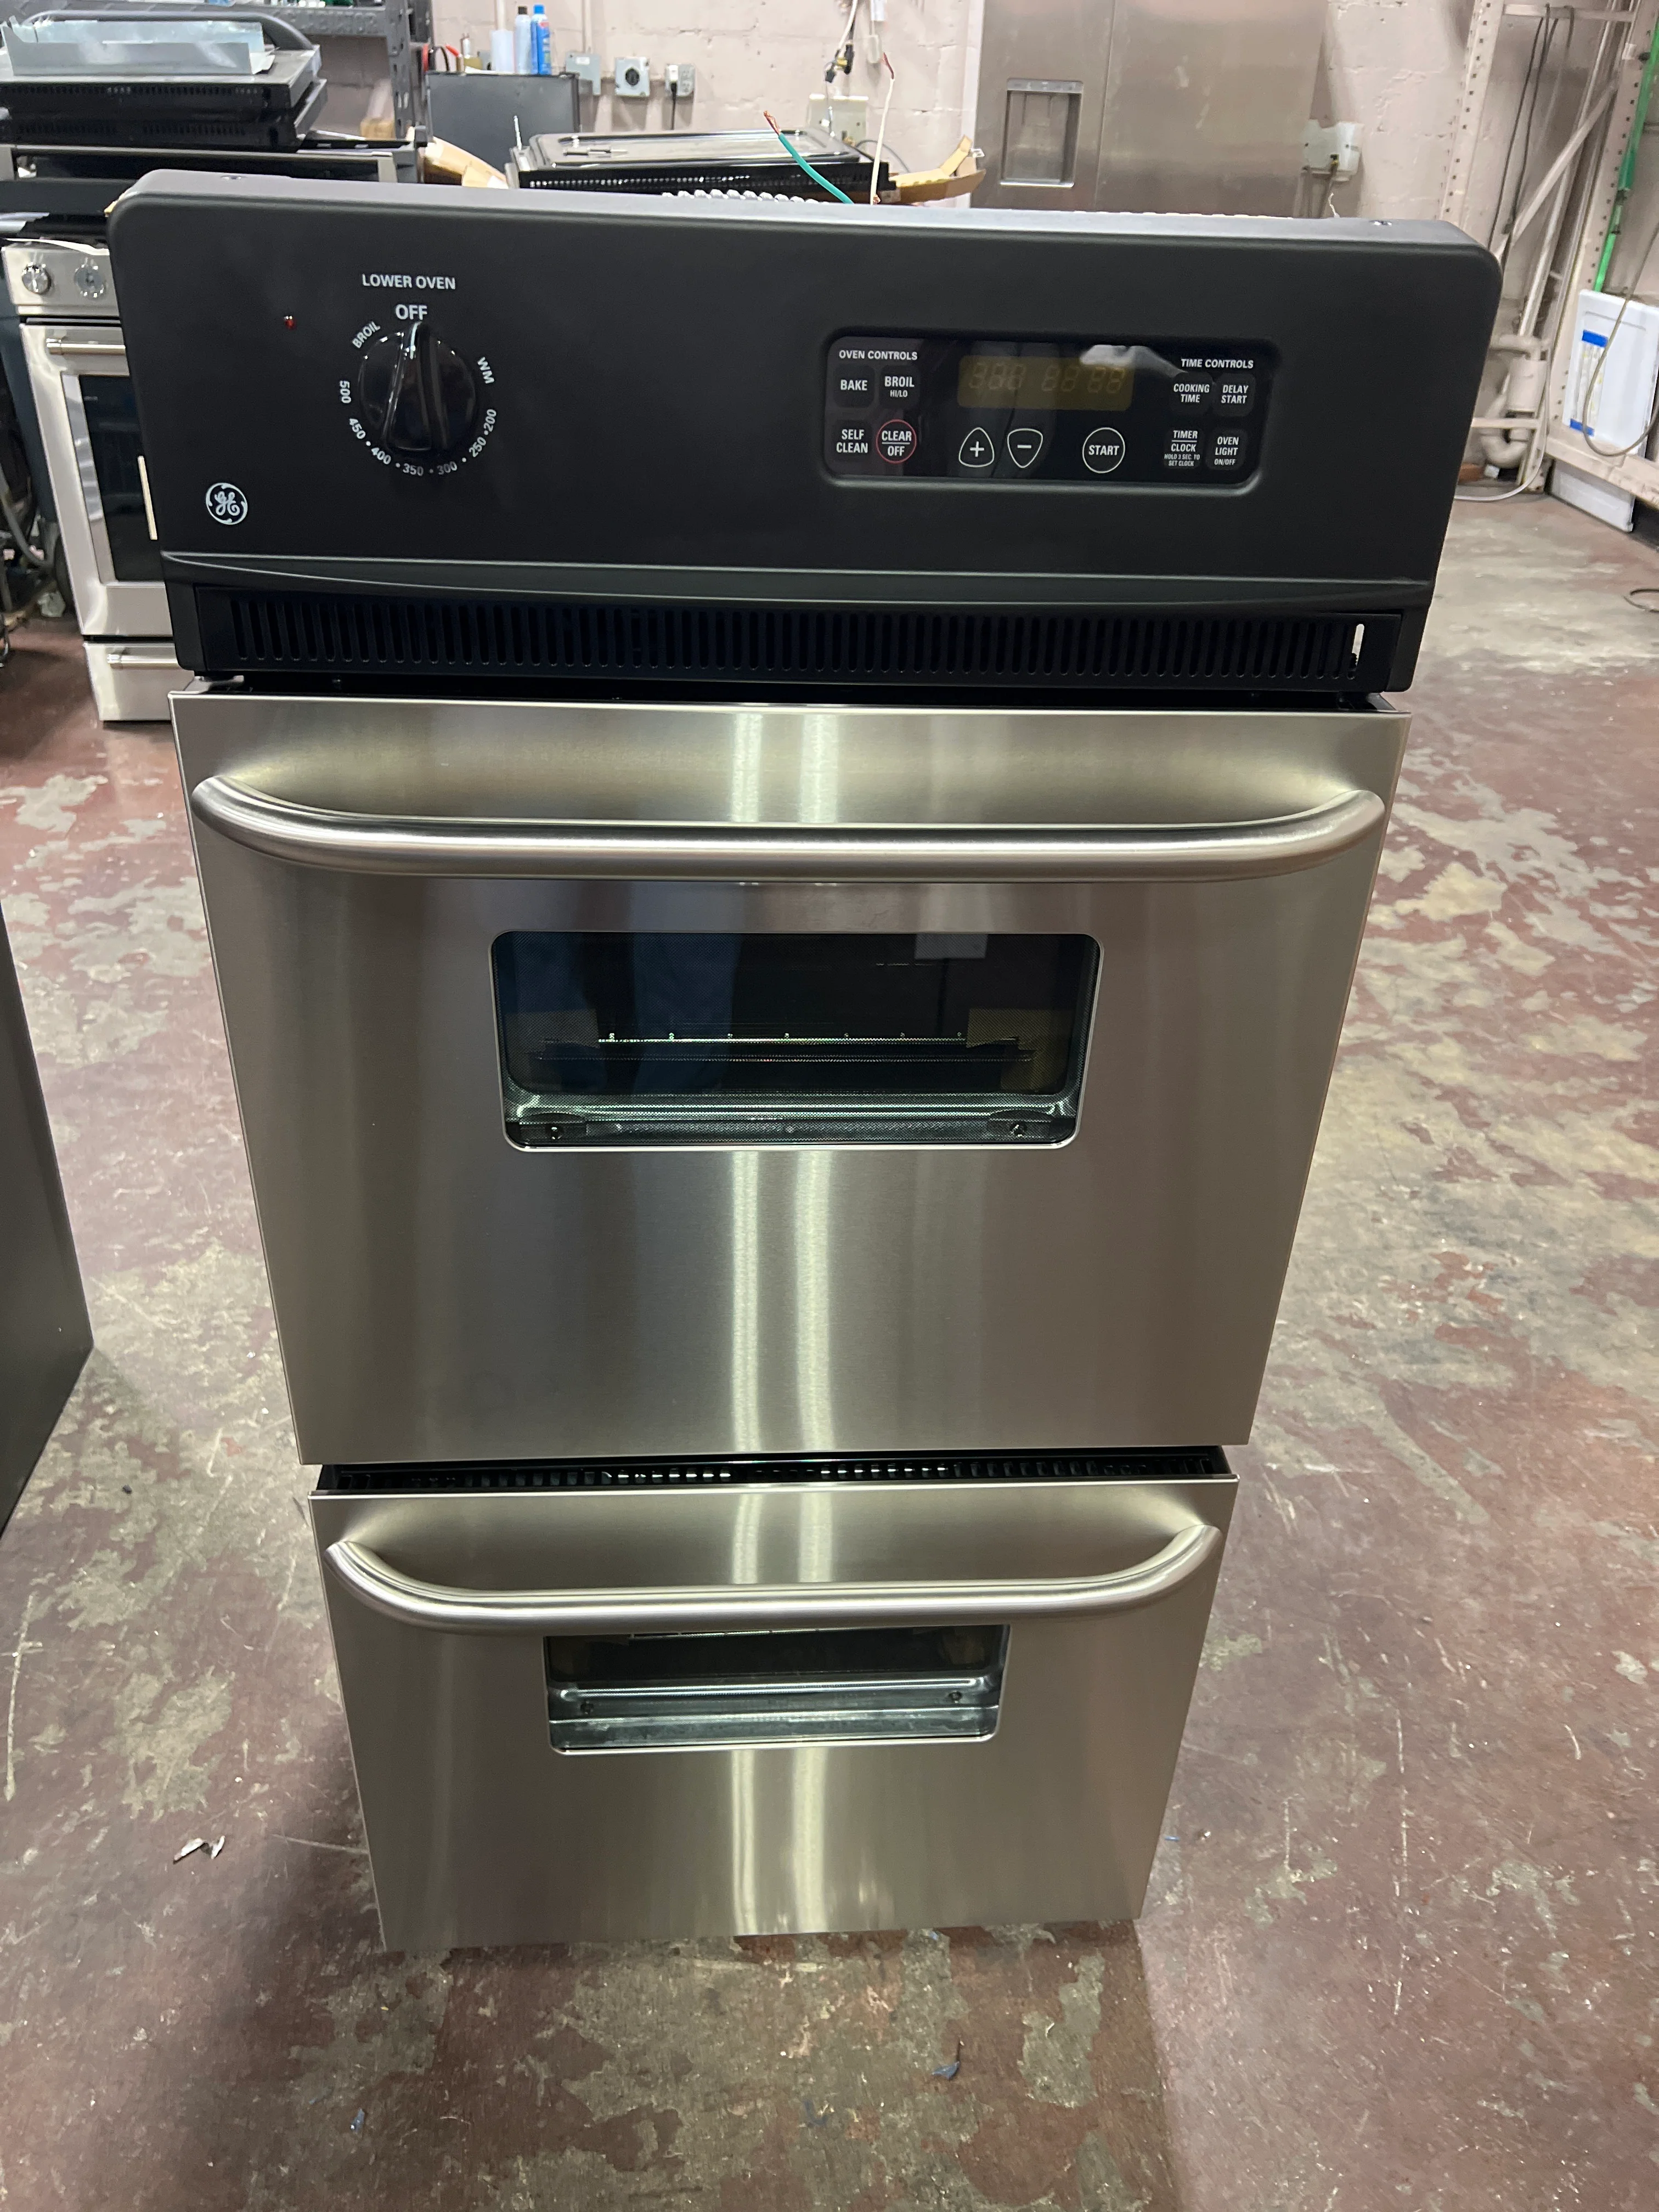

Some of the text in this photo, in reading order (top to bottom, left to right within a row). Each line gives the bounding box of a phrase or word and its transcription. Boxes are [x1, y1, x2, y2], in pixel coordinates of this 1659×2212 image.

[362, 274, 456, 290] LOWER OVEN
[395, 304, 428, 320] OFF
[352, 321, 381, 348] BROIL
[839, 349, 918, 360] OVEN CONTROLS
[1181, 358, 1254, 369] TIME CONTROLS
[477, 357, 495, 384] WM
[840, 379, 868, 391] BAKE
[884, 376, 915, 387] BROIL
[339, 380, 352, 404] 500
[890, 390, 908, 398] HI/LO
[1173, 383, 1210, 393] COOKING
[1222, 385, 1249, 394] DELAY
[1180, 393, 1200, 403] TIME
[1221, 394, 1248, 404] START
[486, 409, 497, 431] 200
[349, 418, 366, 439] 450
[841, 428, 865, 440] SELF
[1173, 430, 1198, 439] TIMER
[882, 430, 912, 441] CLEAR
[1217, 436, 1239, 445] OVEN
[469, 436, 487, 458] 250
[836, 442, 868, 454] CLEAN
[887, 445, 905, 456] OFF
[1088, 444, 1120, 456] START
[1171, 443, 1197, 452] CLOCK
[1215, 447, 1239, 456] LIGHT
[371, 447, 391, 465] 400
[402, 462, 424, 476] 350
[437, 461, 458, 475] 300
